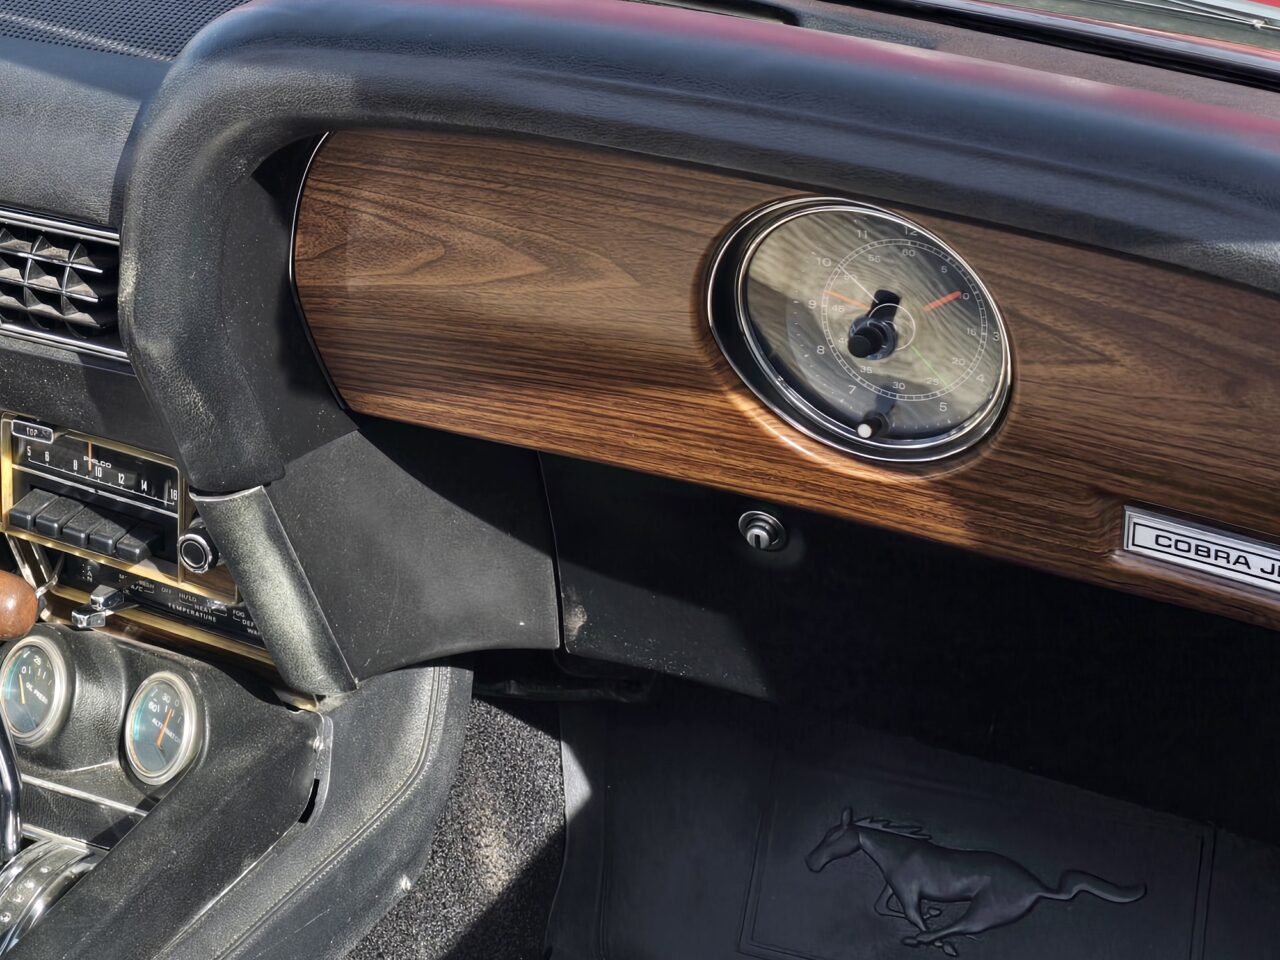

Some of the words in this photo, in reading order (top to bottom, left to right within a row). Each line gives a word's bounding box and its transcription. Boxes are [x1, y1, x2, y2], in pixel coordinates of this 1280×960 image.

[856, 229, 868, 239] 11
[903, 226, 919, 236] 12
[901, 248, 916, 257] 60
[817, 257, 832, 267] 10
[869, 254, 881, 263] 55
[940, 265, 948, 274] 5
[808, 299, 817, 310] 9
[831, 304, 845, 313] 45
[966, 327, 977, 336] 15
[992, 330, 1000, 342] 3
[816, 345, 825, 356] 8
[951, 357, 966, 367] 20
[859, 365, 873, 374] 35
[926, 377, 941, 386] 25
[975, 374, 985, 383] 4
[848, 384, 857, 395] 7
[892, 381, 906, 390] 30
[939, 401, 948, 413] 5
[26, 445, 32, 456] 5
[73, 459, 78, 471] 8
[95, 466, 103, 478] 10
[118, 473, 125, 485] 12
[140, 480, 148, 492] 14
[1154, 534, 1252, 570] COBRA
[1259, 563, 1280, 576] J
[168, 602, 218, 624] TEMPERATURE
[194, 603, 212, 614] HEAT
[232, 609, 246, 619] FOG
